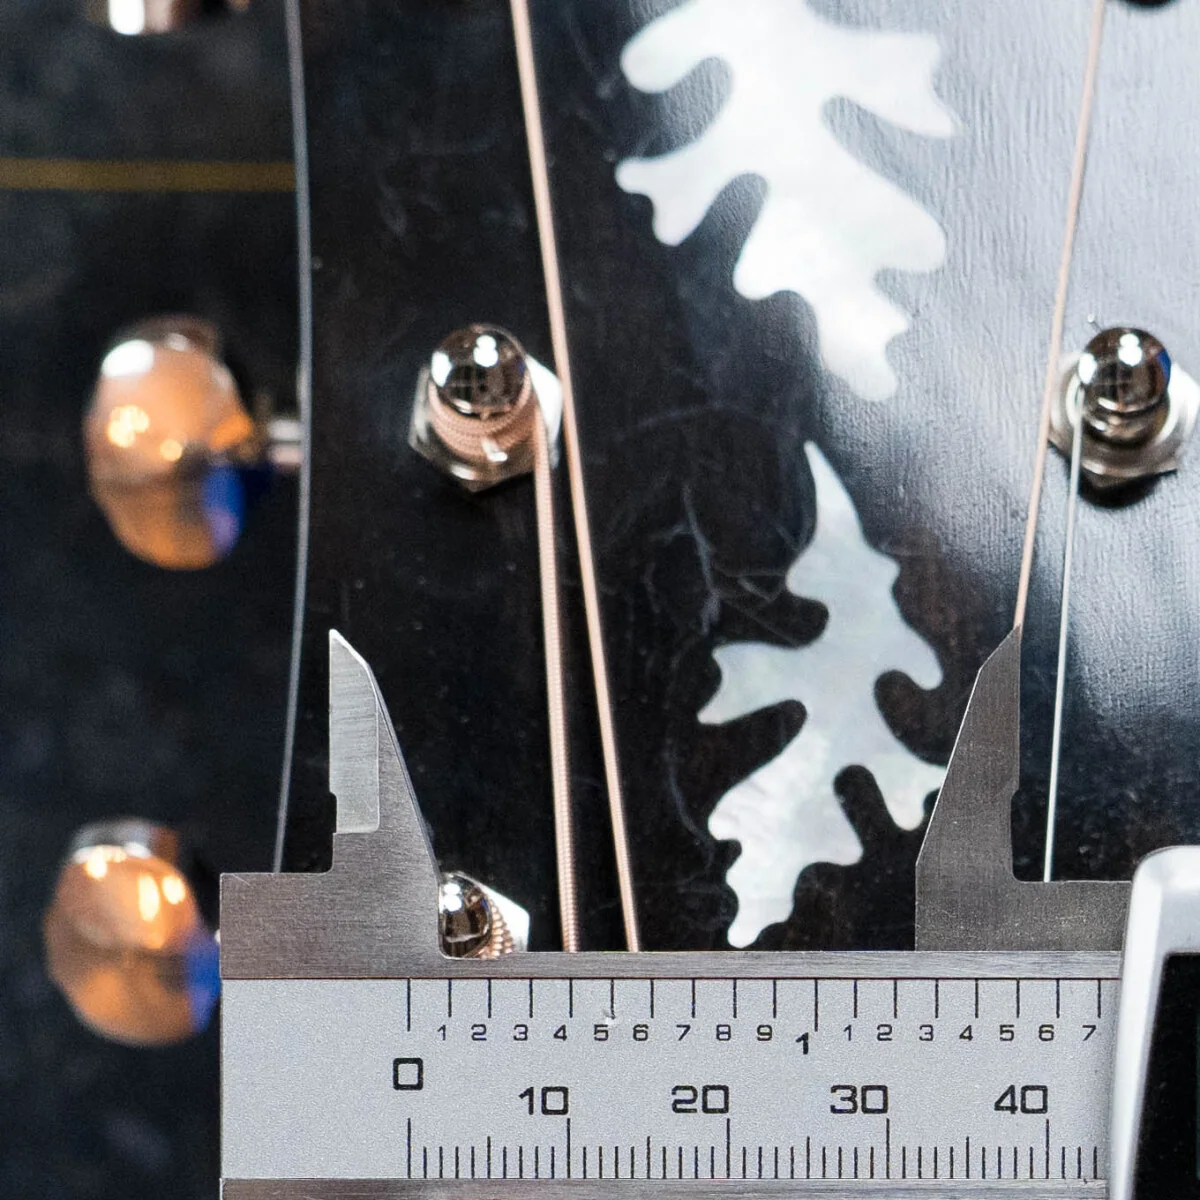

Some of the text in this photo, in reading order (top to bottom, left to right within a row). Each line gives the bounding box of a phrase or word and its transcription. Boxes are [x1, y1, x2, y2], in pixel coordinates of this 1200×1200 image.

[437, 1024, 1097, 1055] 1 2 3 4 5 6 7 8 9 1 1 2 3 4 5 6 7
[392, 1057, 424, 1091] 0
[518, 1085, 1049, 1116] 10 20 30 40
